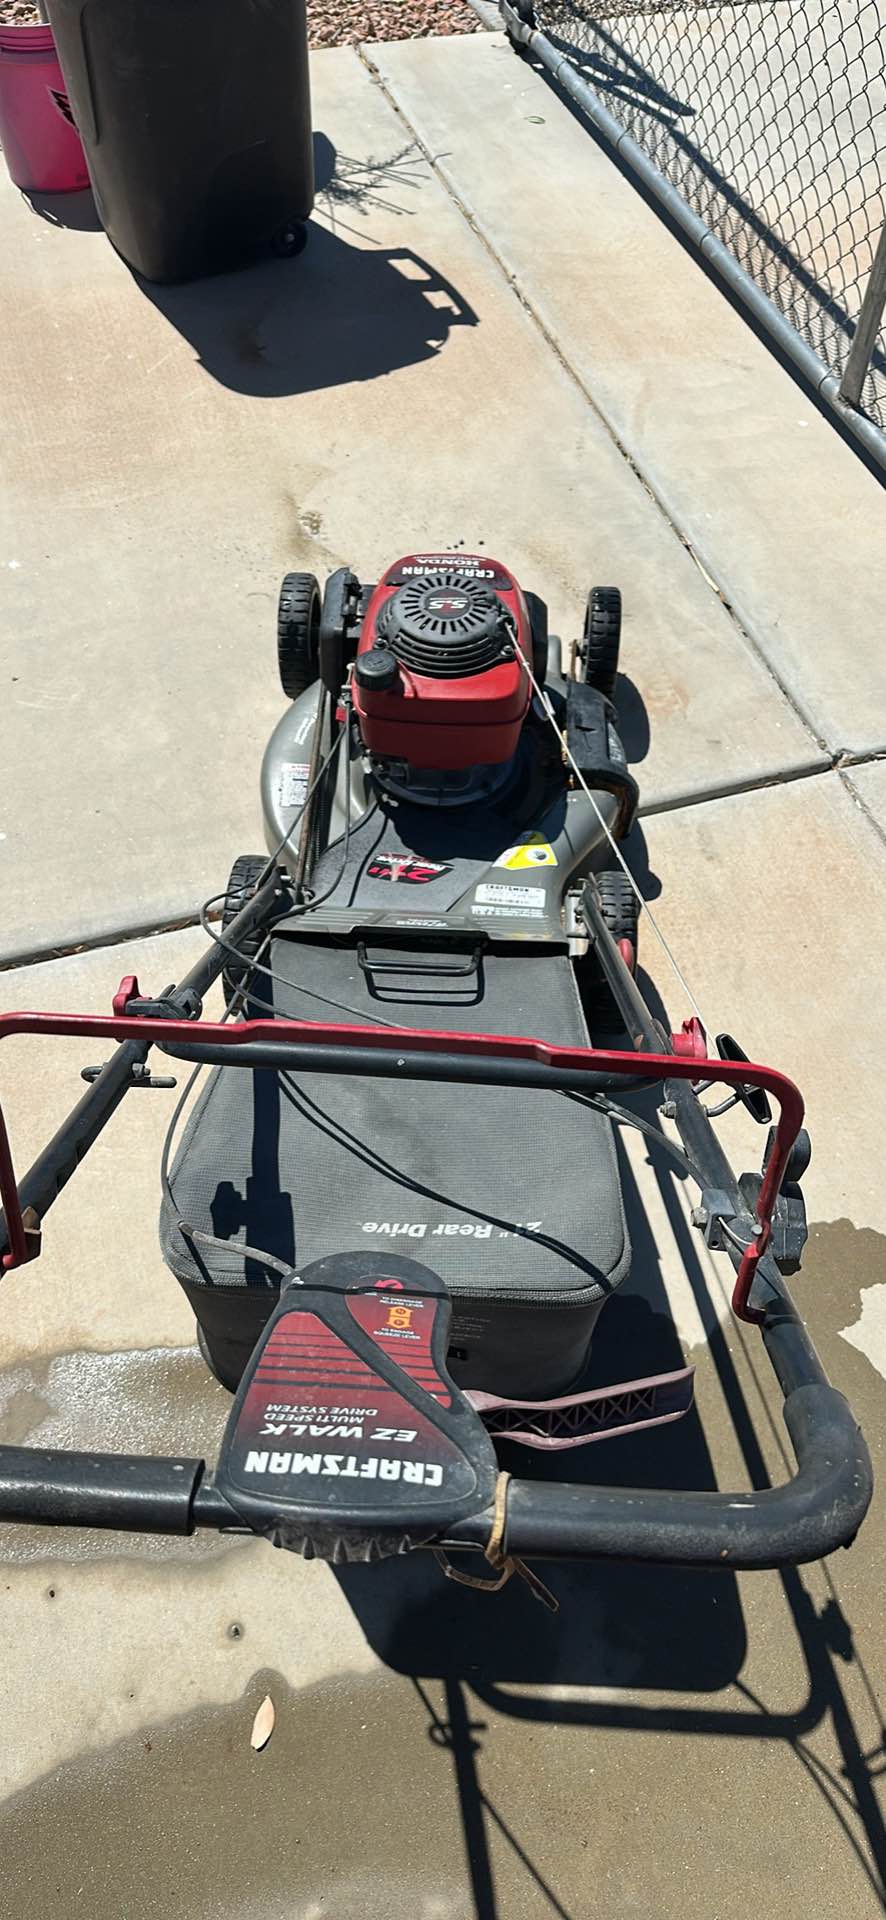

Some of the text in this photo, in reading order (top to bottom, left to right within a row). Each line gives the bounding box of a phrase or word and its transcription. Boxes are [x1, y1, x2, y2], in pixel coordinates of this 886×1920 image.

[428, 600, 468, 609] 5.5
[361, 1222, 428, 1238] Drive
[432, 1223, 493, 1239] Rear
[267, 1403, 378, 1416] DRIVE SYSTEM
[264, 1413, 364, 1424] MULTI SPEED
[260, 1423, 418, 1442] EZ WALK
[244, 1450, 444, 1487] CRAFTSMAN
